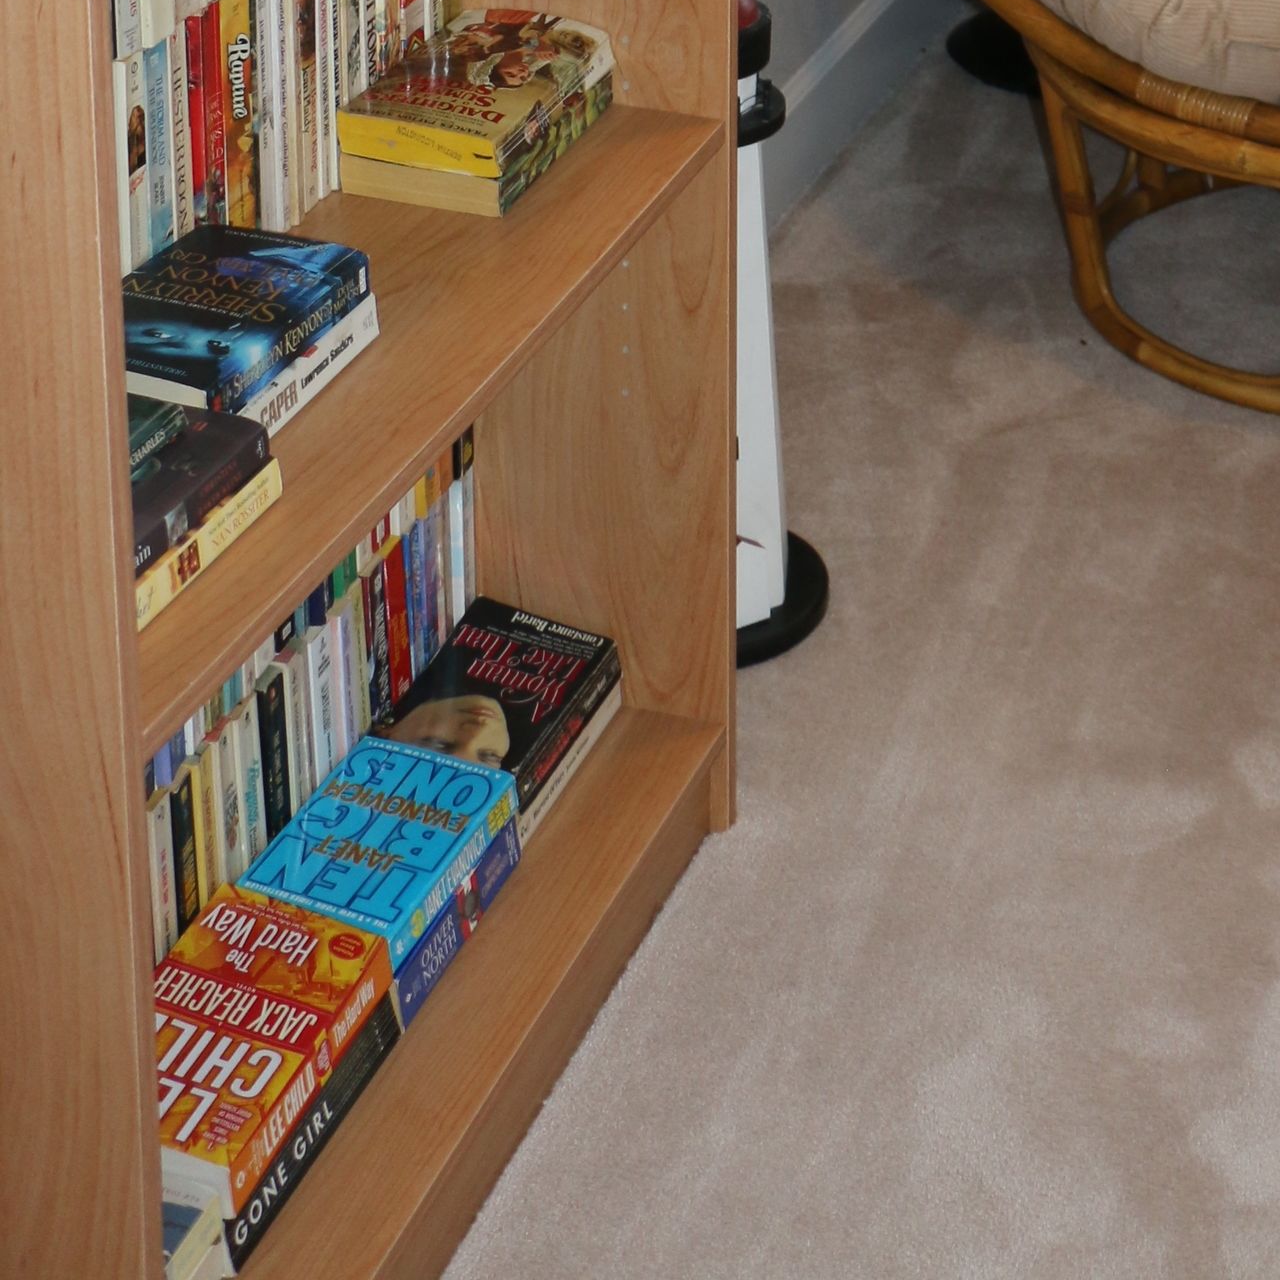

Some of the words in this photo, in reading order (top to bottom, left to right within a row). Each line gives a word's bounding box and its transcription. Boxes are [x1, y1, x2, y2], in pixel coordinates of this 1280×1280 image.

[227, 34, 251, 120] Rapture
[366, 19, 377, 86] HOME
[156, 100, 165, 138] STORM
[161, 249, 207, 264] CRY
[121, 275, 285, 323] SHERRILYN
[156, 264, 283, 301] KENYON
[233, 340, 284, 400] SHERRILYN
[284, 309, 324, 355] KENYON
[260, 379, 299, 428] CAPER
[300, 357, 330, 390] Lawrence
[330, 333, 354, 363] Sanders
[131, 428, 167, 466] CHARLES
[452, 624, 517, 666] That
[510, 610, 548, 631] Bartel
[548, 623, 604, 648] Constance
[466, 657, 565, 703] Woman
[522, 647, 586, 679] Like
[366, 740, 399, 752] NOVEL
[322, 779, 470, 833] EVANOVICH
[344, 747, 492, 816] ONES
[297, 793, 463, 872] BIG
[312, 834, 403, 872] JANET
[238, 832, 420, 924] TEN
[445, 828, 487, 890] EVANOVICH
[200, 902, 255, 953] Way
[315, 901, 338, 913] YORK
[339, 908, 357, 918] NEW
[225, 950, 256, 973] The
[255, 924, 318, 967] Hard
[421, 913, 454, 969] OLIVER
[422, 932, 458, 987] NORTH
[154, 965, 257, 1026] REACHER
[332, 1022, 348, 1049] The
[346, 999, 363, 1032] Hard
[360, 976, 376, 1010] Way
[246, 997, 318, 1044] JACK
[155, 1013, 282, 1098] CHIL
[262, 1104, 287, 1158] LEE
[283, 1061, 317, 1122] CHILD
[234, 1161, 290, 1246] GONE
[294, 1099, 334, 1161] GIRL
